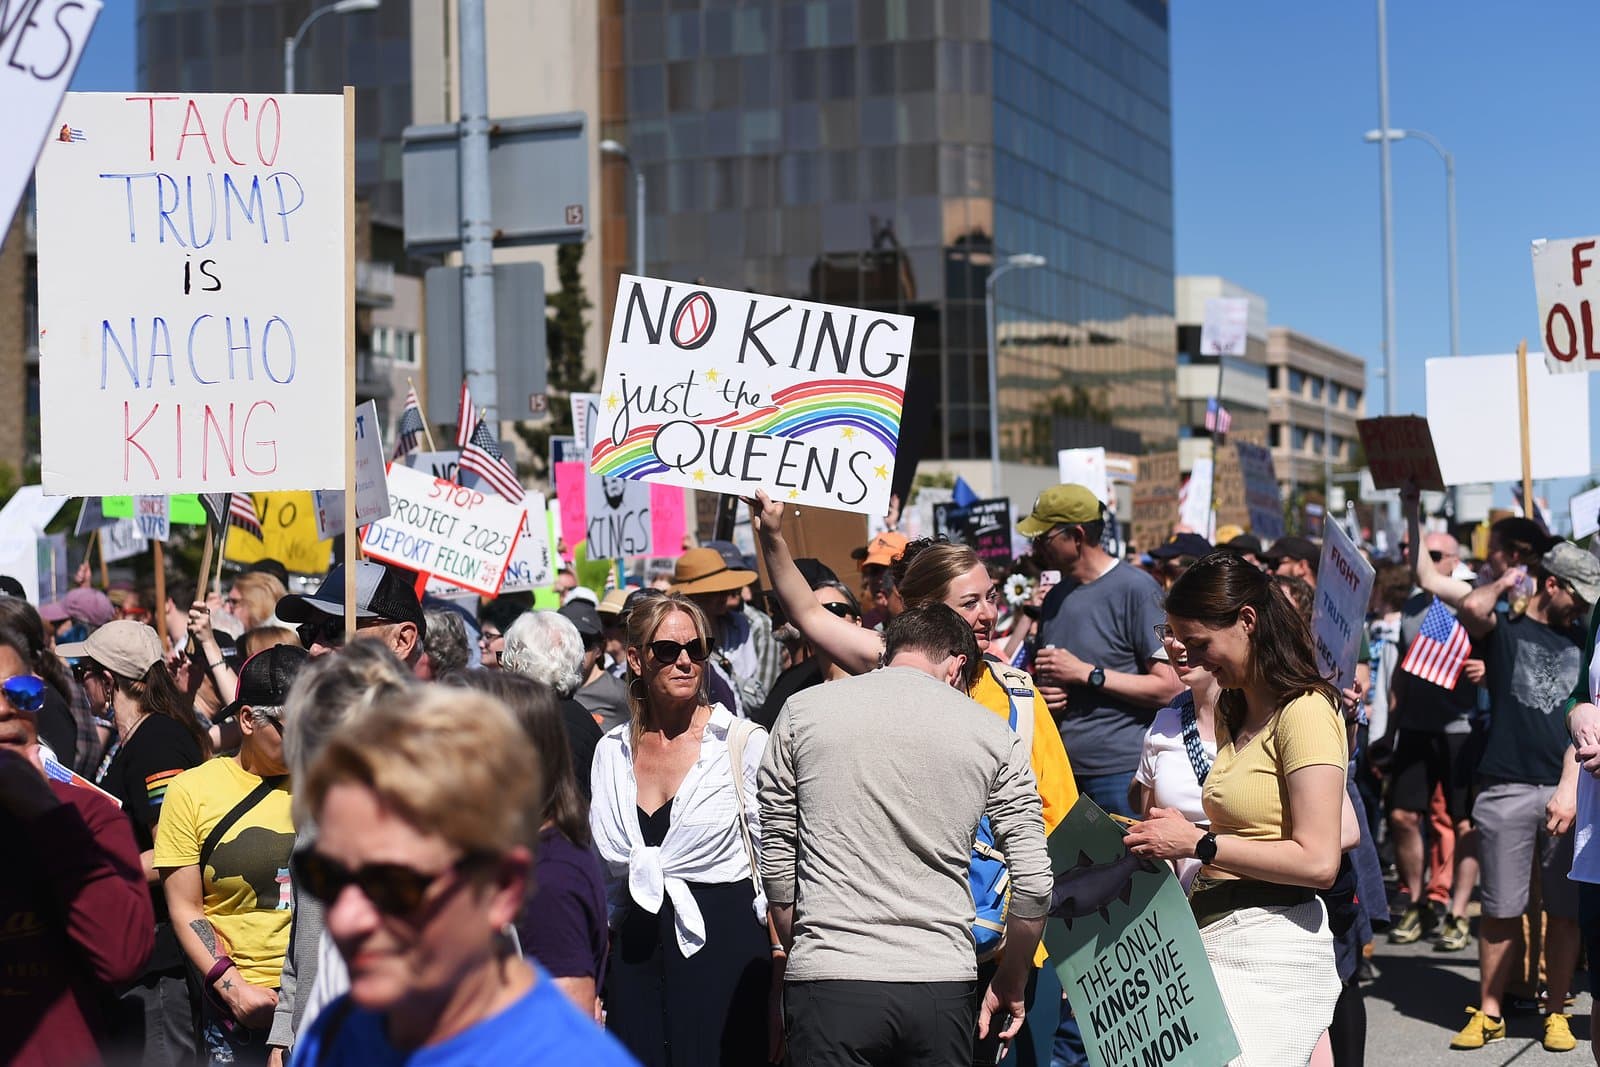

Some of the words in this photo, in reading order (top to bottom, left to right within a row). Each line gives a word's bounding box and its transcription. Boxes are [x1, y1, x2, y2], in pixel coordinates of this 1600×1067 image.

[125, 96, 281, 167] TACO
[99, 171, 305, 249] TRUMP
[100, 313, 297, 390] NACHO
[620, 280, 718, 350] NO
[736, 298, 905, 378] KING
[123, 400, 278, 481] KING
[611, 369, 703, 447] just
[716, 378, 782, 411] the
[428, 481, 485, 511] STOP
[651, 419, 873, 505] QUEENS
[139, 500, 165, 515] SINCE
[140, 516, 166, 535] 1776
[462, 524, 511, 557] 2025
[586, 507, 650, 560] KINGS
[365, 520, 435, 564] DEPORT
[433, 545, 482, 582] FELON
[1330, 545, 1361, 593] FIGHT
[1322, 591, 1352, 642] TRUTH
[1316, 634, 1344, 683] DECAY
[1076, 955, 1118, 1005] THE
[1115, 909, 1165, 973] ONLY
[1089, 967, 1151, 1039] KINGS
[1148, 938, 1184, 986] WE
[1098, 1004, 1151, 1067] WANT
[1155, 971, 1195, 1027] ARE
